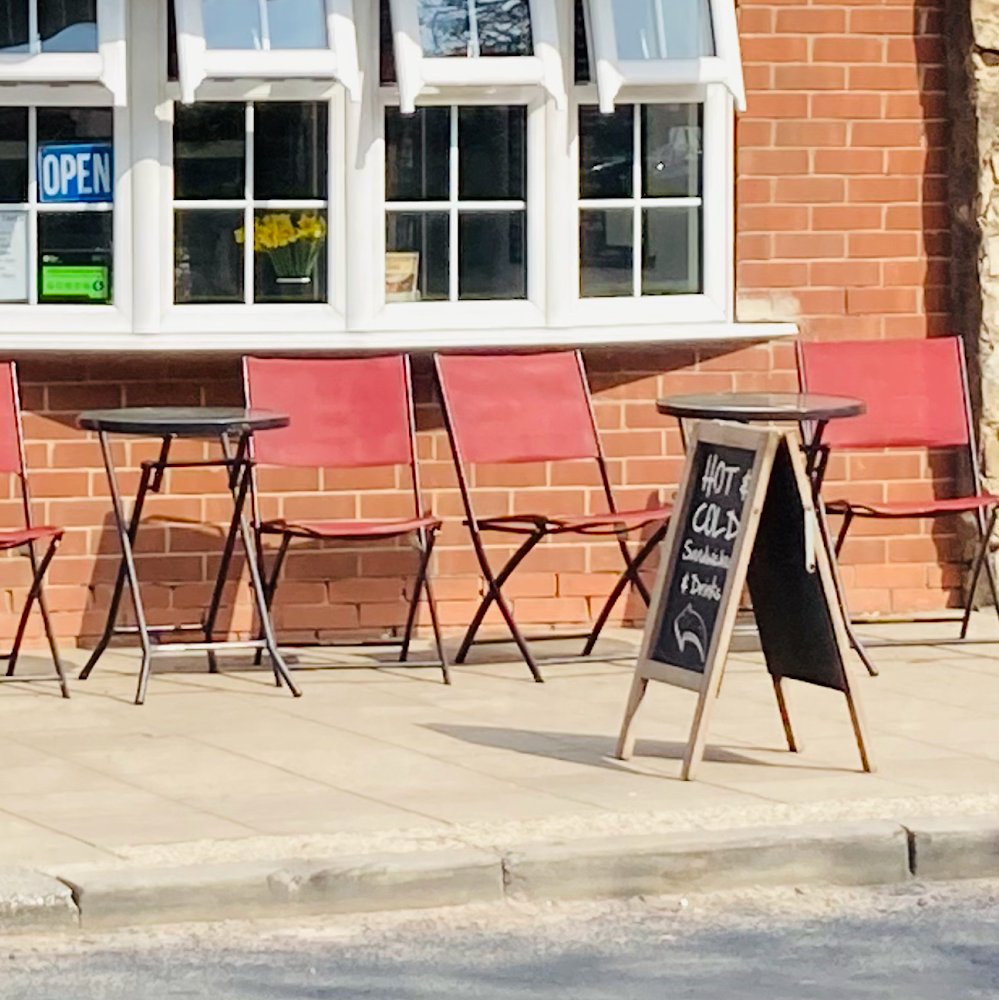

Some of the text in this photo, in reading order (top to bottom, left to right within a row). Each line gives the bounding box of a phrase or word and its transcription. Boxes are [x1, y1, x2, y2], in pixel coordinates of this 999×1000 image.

[42, 152, 111, 196] OPEN
[701, 453, 740, 498] HOT
[691, 501, 741, 541] COLD
